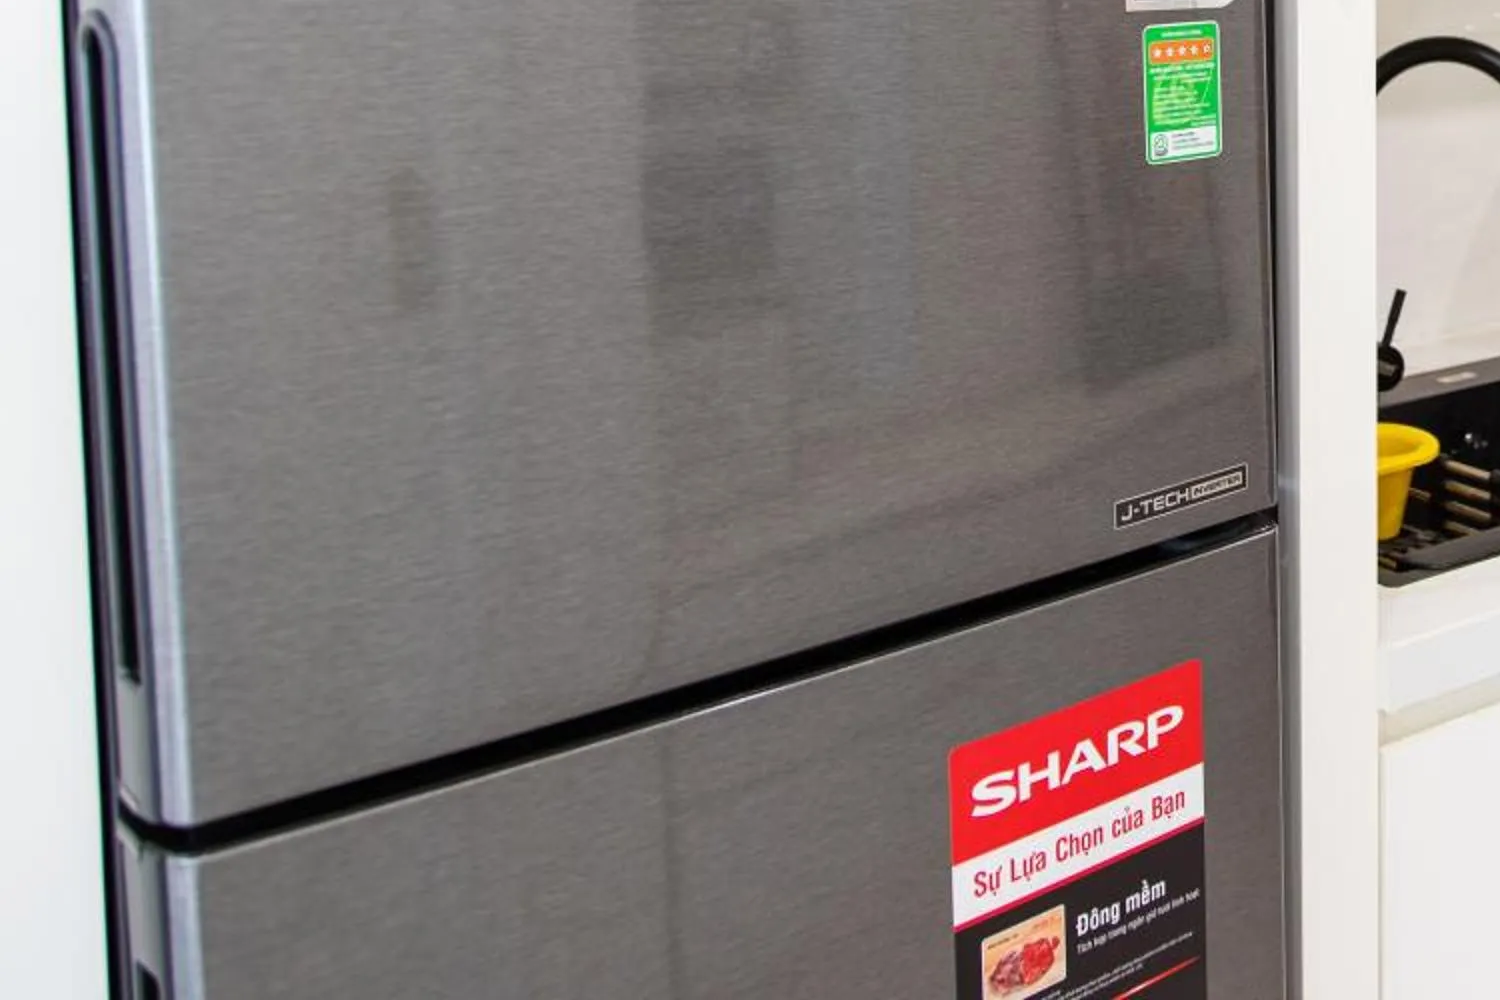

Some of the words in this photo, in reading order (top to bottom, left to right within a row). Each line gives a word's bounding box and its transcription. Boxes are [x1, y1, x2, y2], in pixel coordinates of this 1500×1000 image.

[971, 704, 1184, 817] SHARP
[1055, 825, 1104, 863] Chọn
[1111, 807, 1143, 838] của
[1151, 791, 1185, 821] Bạn
